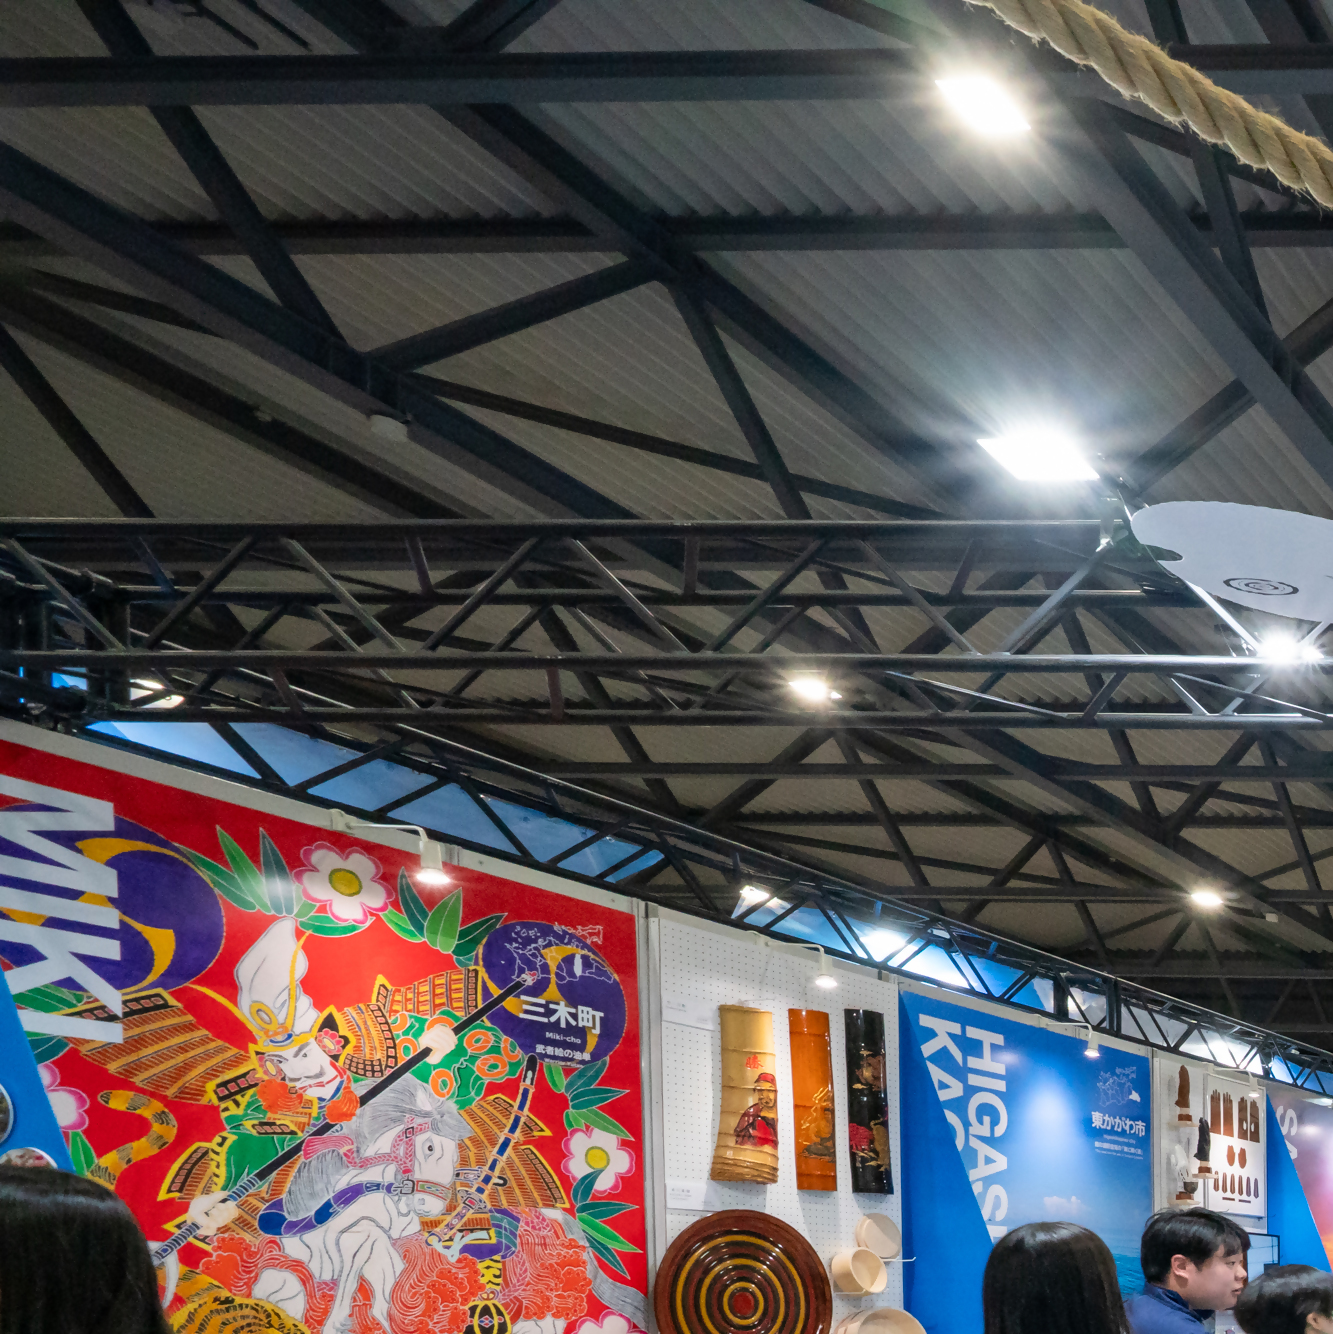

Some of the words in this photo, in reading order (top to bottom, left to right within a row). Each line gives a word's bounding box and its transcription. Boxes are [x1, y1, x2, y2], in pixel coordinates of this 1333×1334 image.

[0, 774, 124, 1044] MIKI
[519, 995, 604, 1034] 三木町
[545, 1031, 581, 1044] Miki-cho
[1091, 1111, 1146, 1137] 東かがわ市
